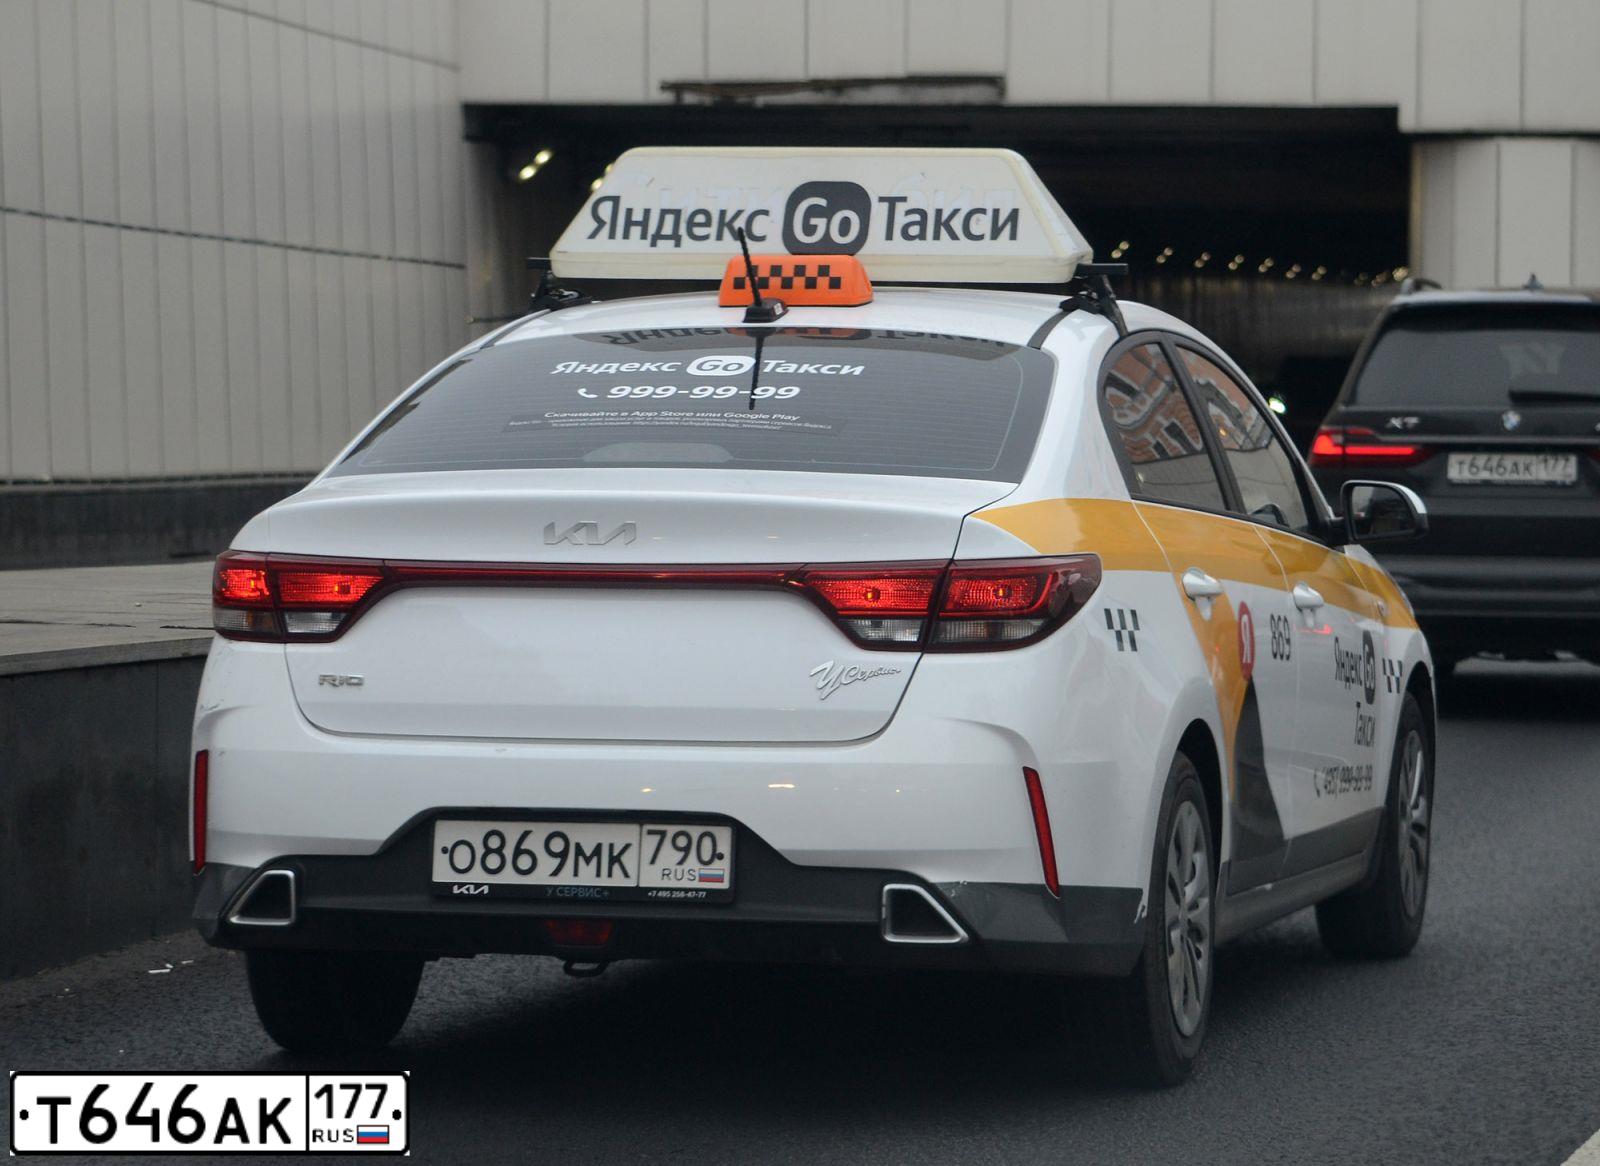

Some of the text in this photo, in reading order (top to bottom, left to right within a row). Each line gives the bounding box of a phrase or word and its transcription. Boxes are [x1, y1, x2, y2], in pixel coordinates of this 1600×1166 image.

[587, 195, 1020, 247] Яндекс Go Такси
[550, 359, 865, 376] Яндекс Go Такси
[606, 385, 801, 399] 999-99-99
[631, 410, 658, 418] App
[723, 412, 770, 420] Google
[772, 413, 800, 421] Play
[543, 520, 637, 546] KIA
[1269, 613, 1292, 661] 869
[1334, 636, 1363, 690] Яндекс
[318, 674, 365, 688] RIO
[646, 829, 717, 866] 790
[661, 867, 697, 882] RUS
[452, 884, 489, 895] KIA
